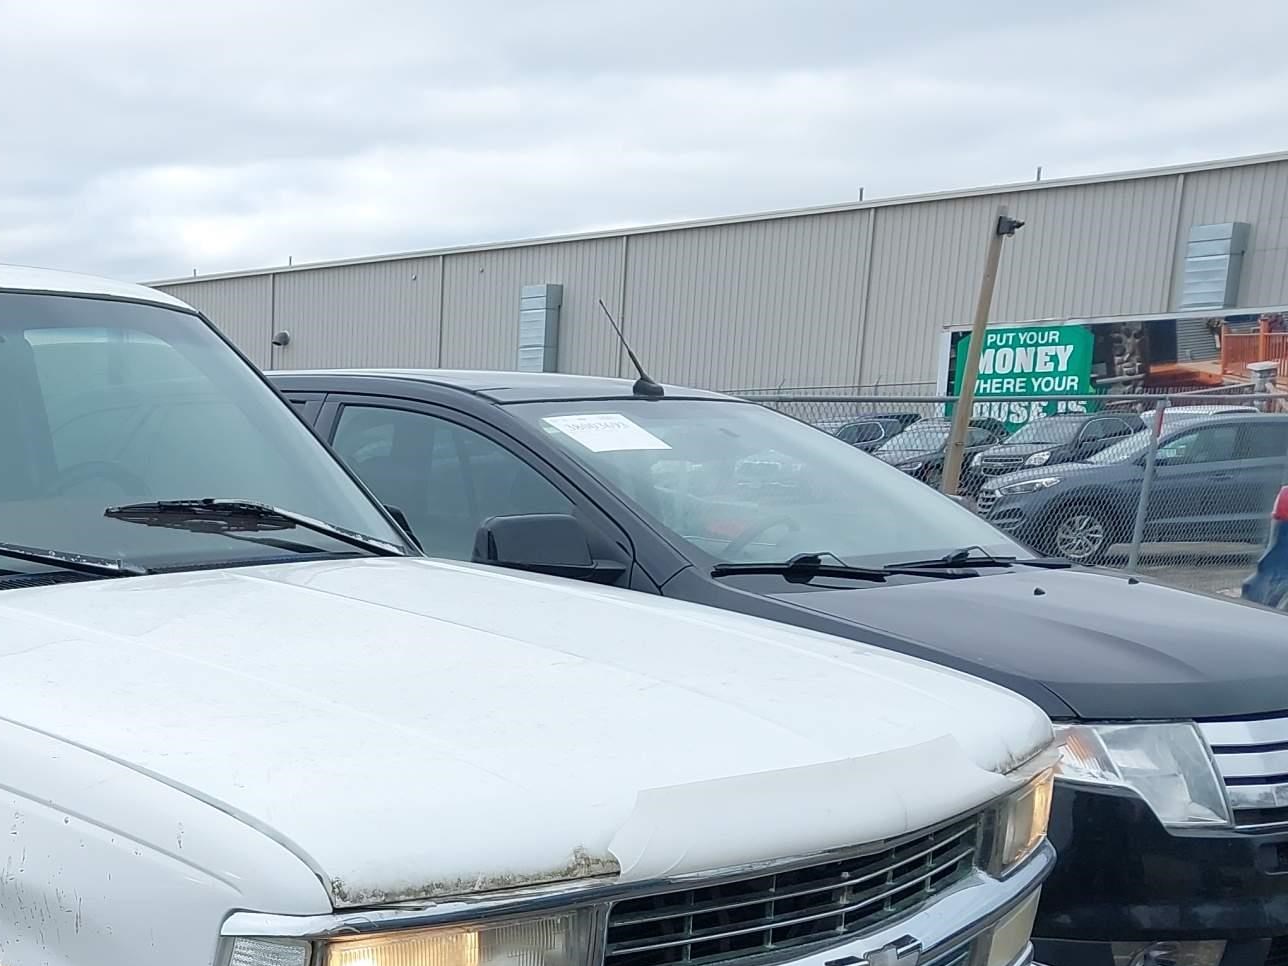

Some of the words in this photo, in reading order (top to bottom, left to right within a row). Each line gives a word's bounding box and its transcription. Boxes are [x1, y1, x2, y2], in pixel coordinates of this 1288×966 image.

[987, 333, 1016, 346] PUT
[1019, 330, 1059, 344] YOUR
[978, 345, 1073, 375] MONEY
[973, 377, 1027, 394] HERE
[1032, 376, 1079, 393] YOUR
[973, 401, 1048, 424] OUSE
